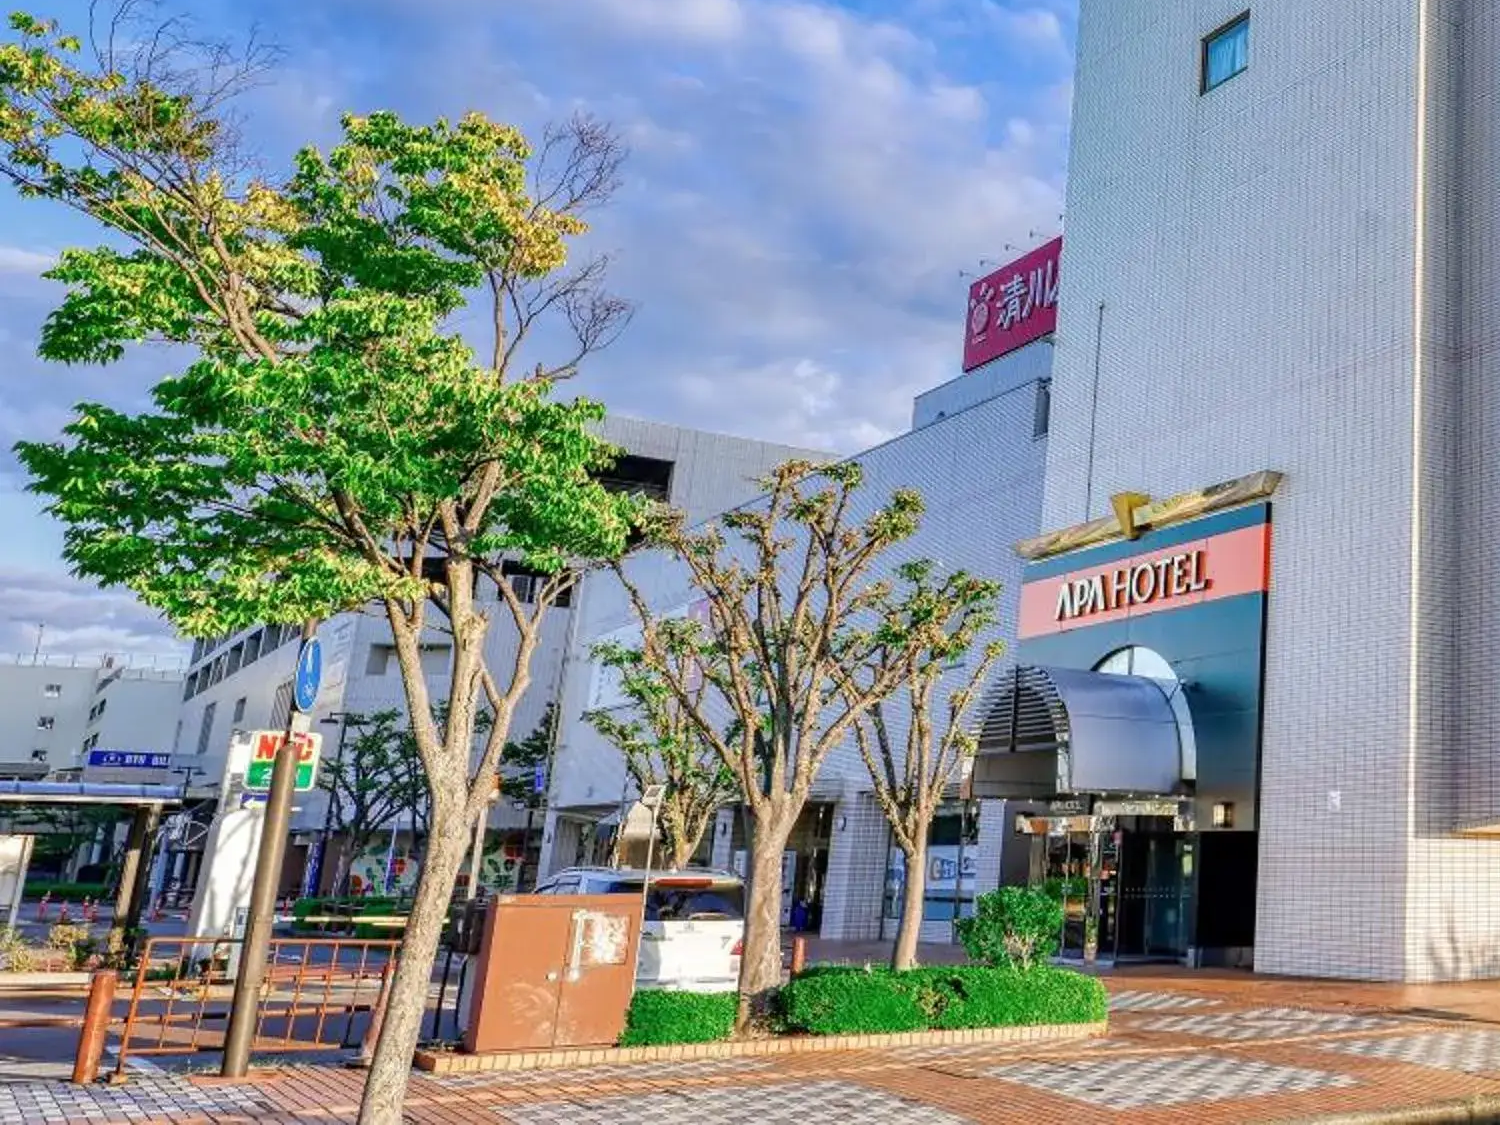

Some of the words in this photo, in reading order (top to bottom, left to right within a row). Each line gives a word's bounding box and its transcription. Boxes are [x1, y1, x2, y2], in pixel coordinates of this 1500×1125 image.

[996, 259, 1060, 331] 清川
[1055, 574, 1106, 621] APA
[1111, 550, 1210, 609] HOTEL
[256, 734, 314, 761] NC
